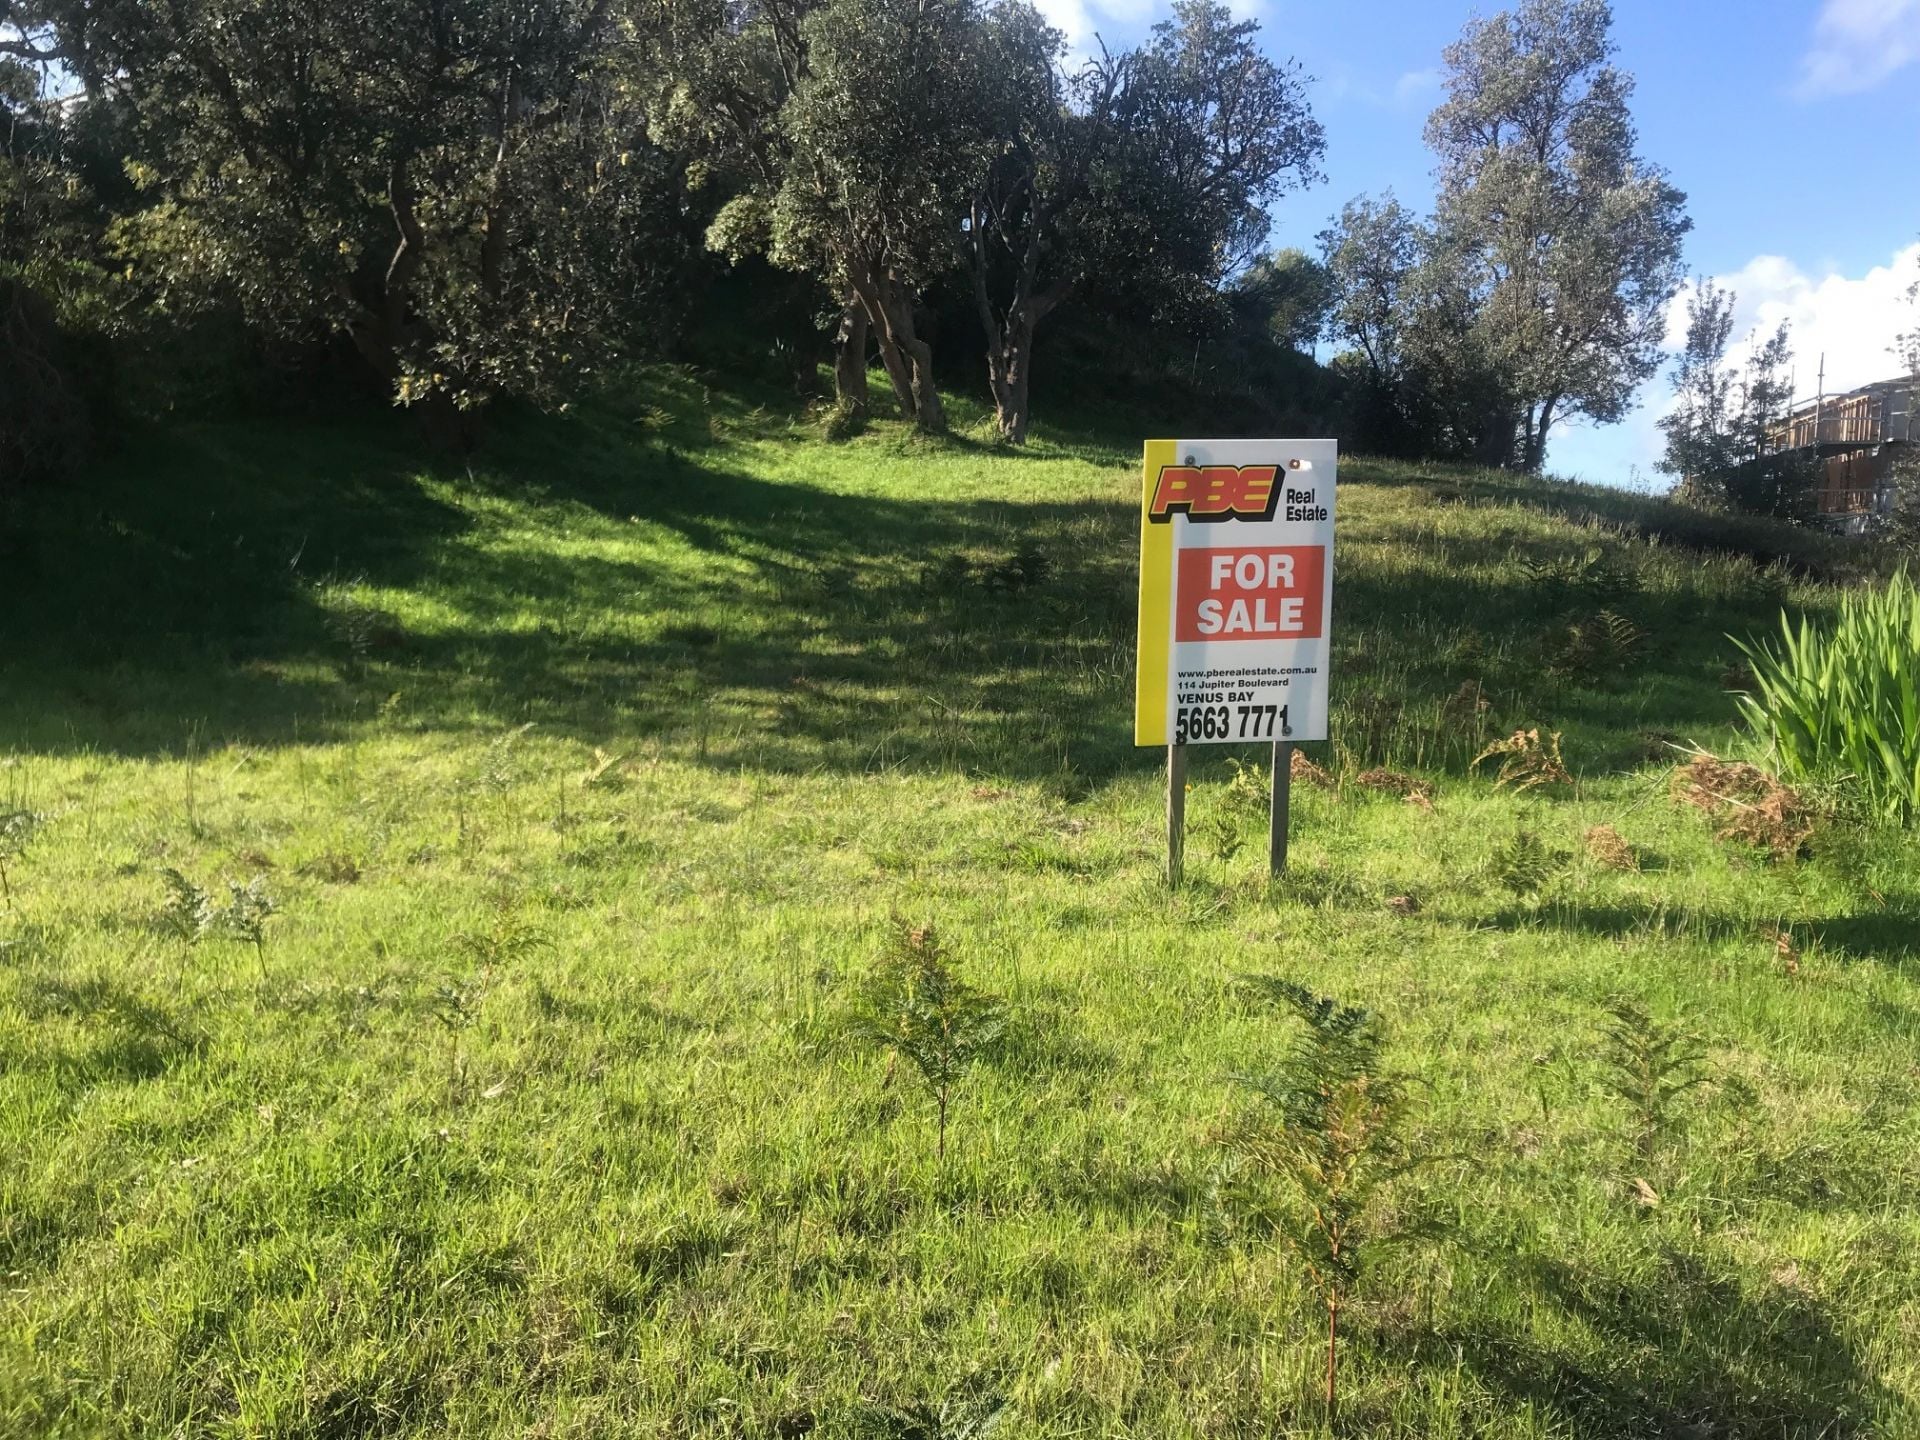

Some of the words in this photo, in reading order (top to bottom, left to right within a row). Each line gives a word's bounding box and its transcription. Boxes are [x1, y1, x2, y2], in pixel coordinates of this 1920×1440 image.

[1149, 464, 1286, 523] PBE
[1286, 488, 1315, 504] Real
[1286, 505, 1328, 521] Estate
[1210, 554, 1295, 590] FOR
[1197, 597, 1304, 634] SALE
[1178, 667, 1317, 679] www.pberealestate.com.au
[1178, 681, 1196, 690] 114
[1199, 680, 1235, 690] Jupiter
[1238, 678, 1289, 688] Boulevard
[1177, 693, 1223, 704] VENUS
[1228, 692, 1254, 703] BAY
[1176, 706, 1230, 740] 5663
[1237, 704, 1289, 737] 7771
